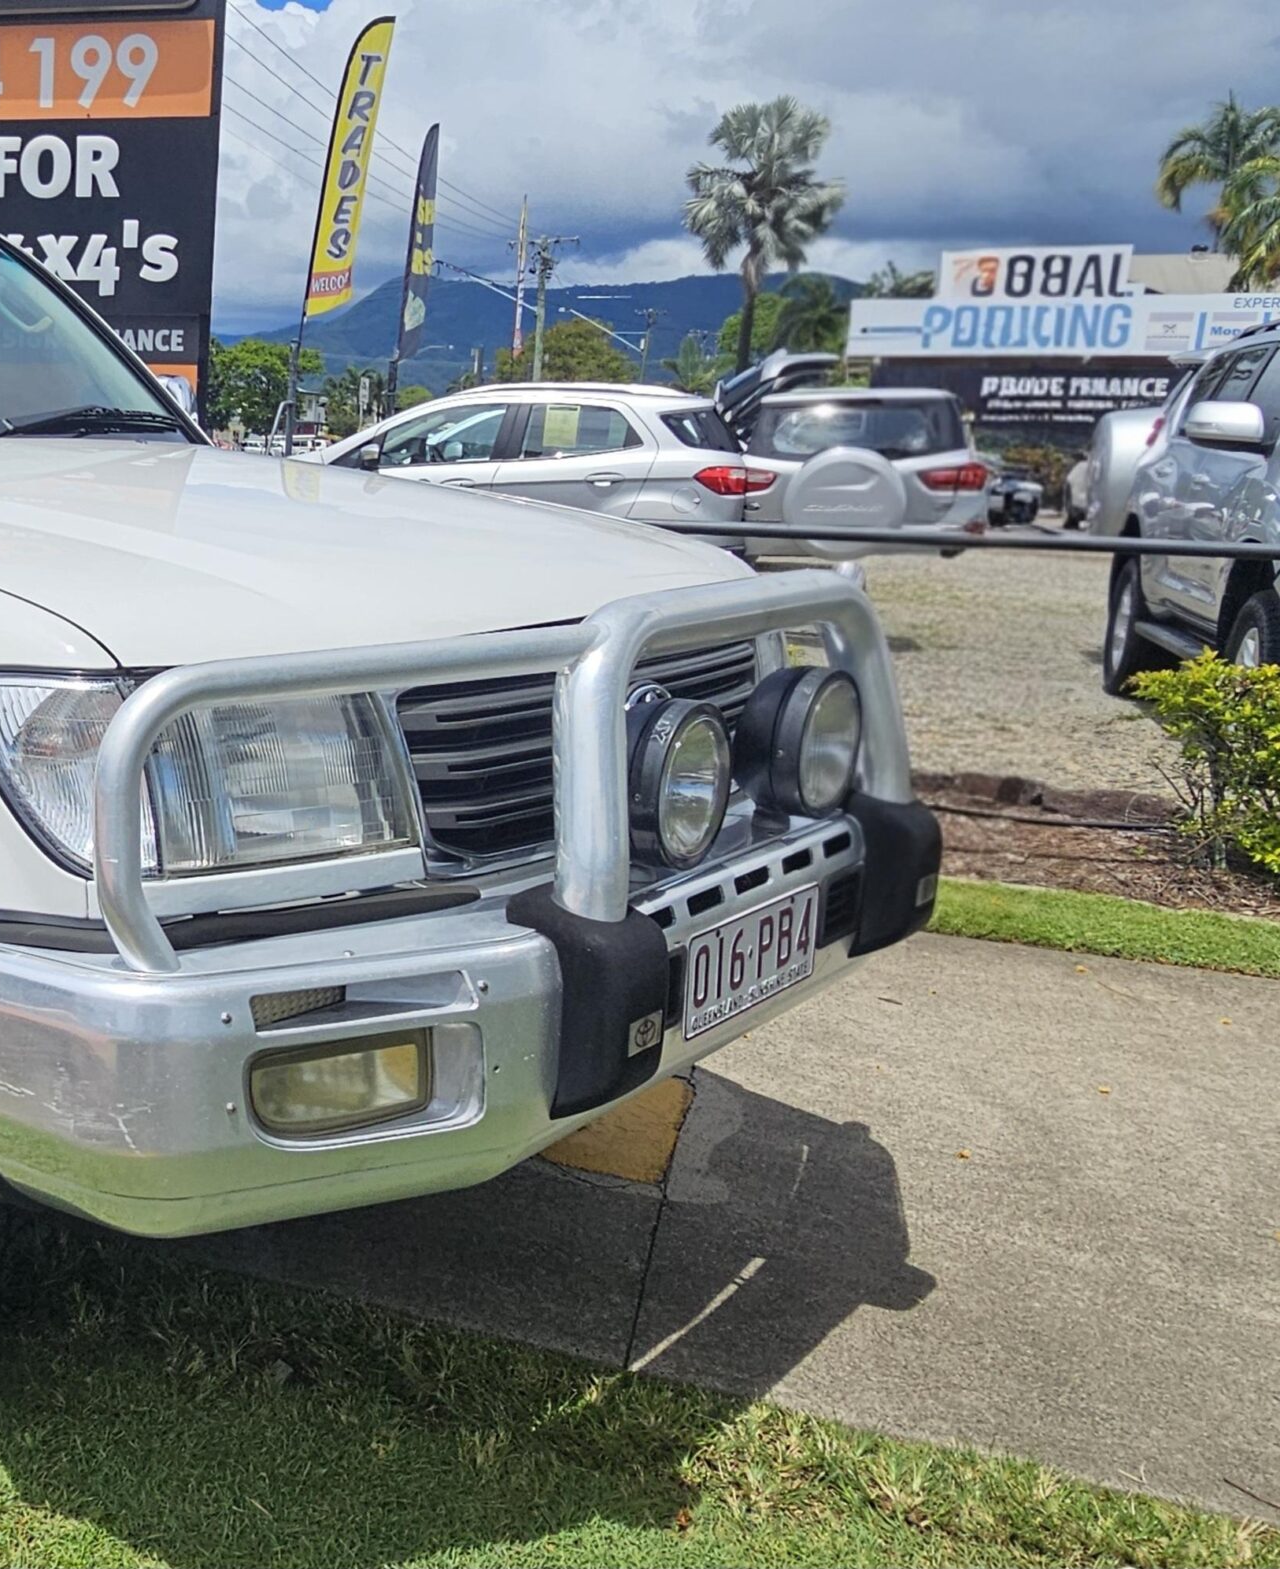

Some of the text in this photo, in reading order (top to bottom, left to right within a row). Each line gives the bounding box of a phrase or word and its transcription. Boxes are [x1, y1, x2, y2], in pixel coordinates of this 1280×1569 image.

[29, 34, 158, 109] 199
[326, 53, 382, 259] TRADES
[115, 328, 185, 352] ANCE
